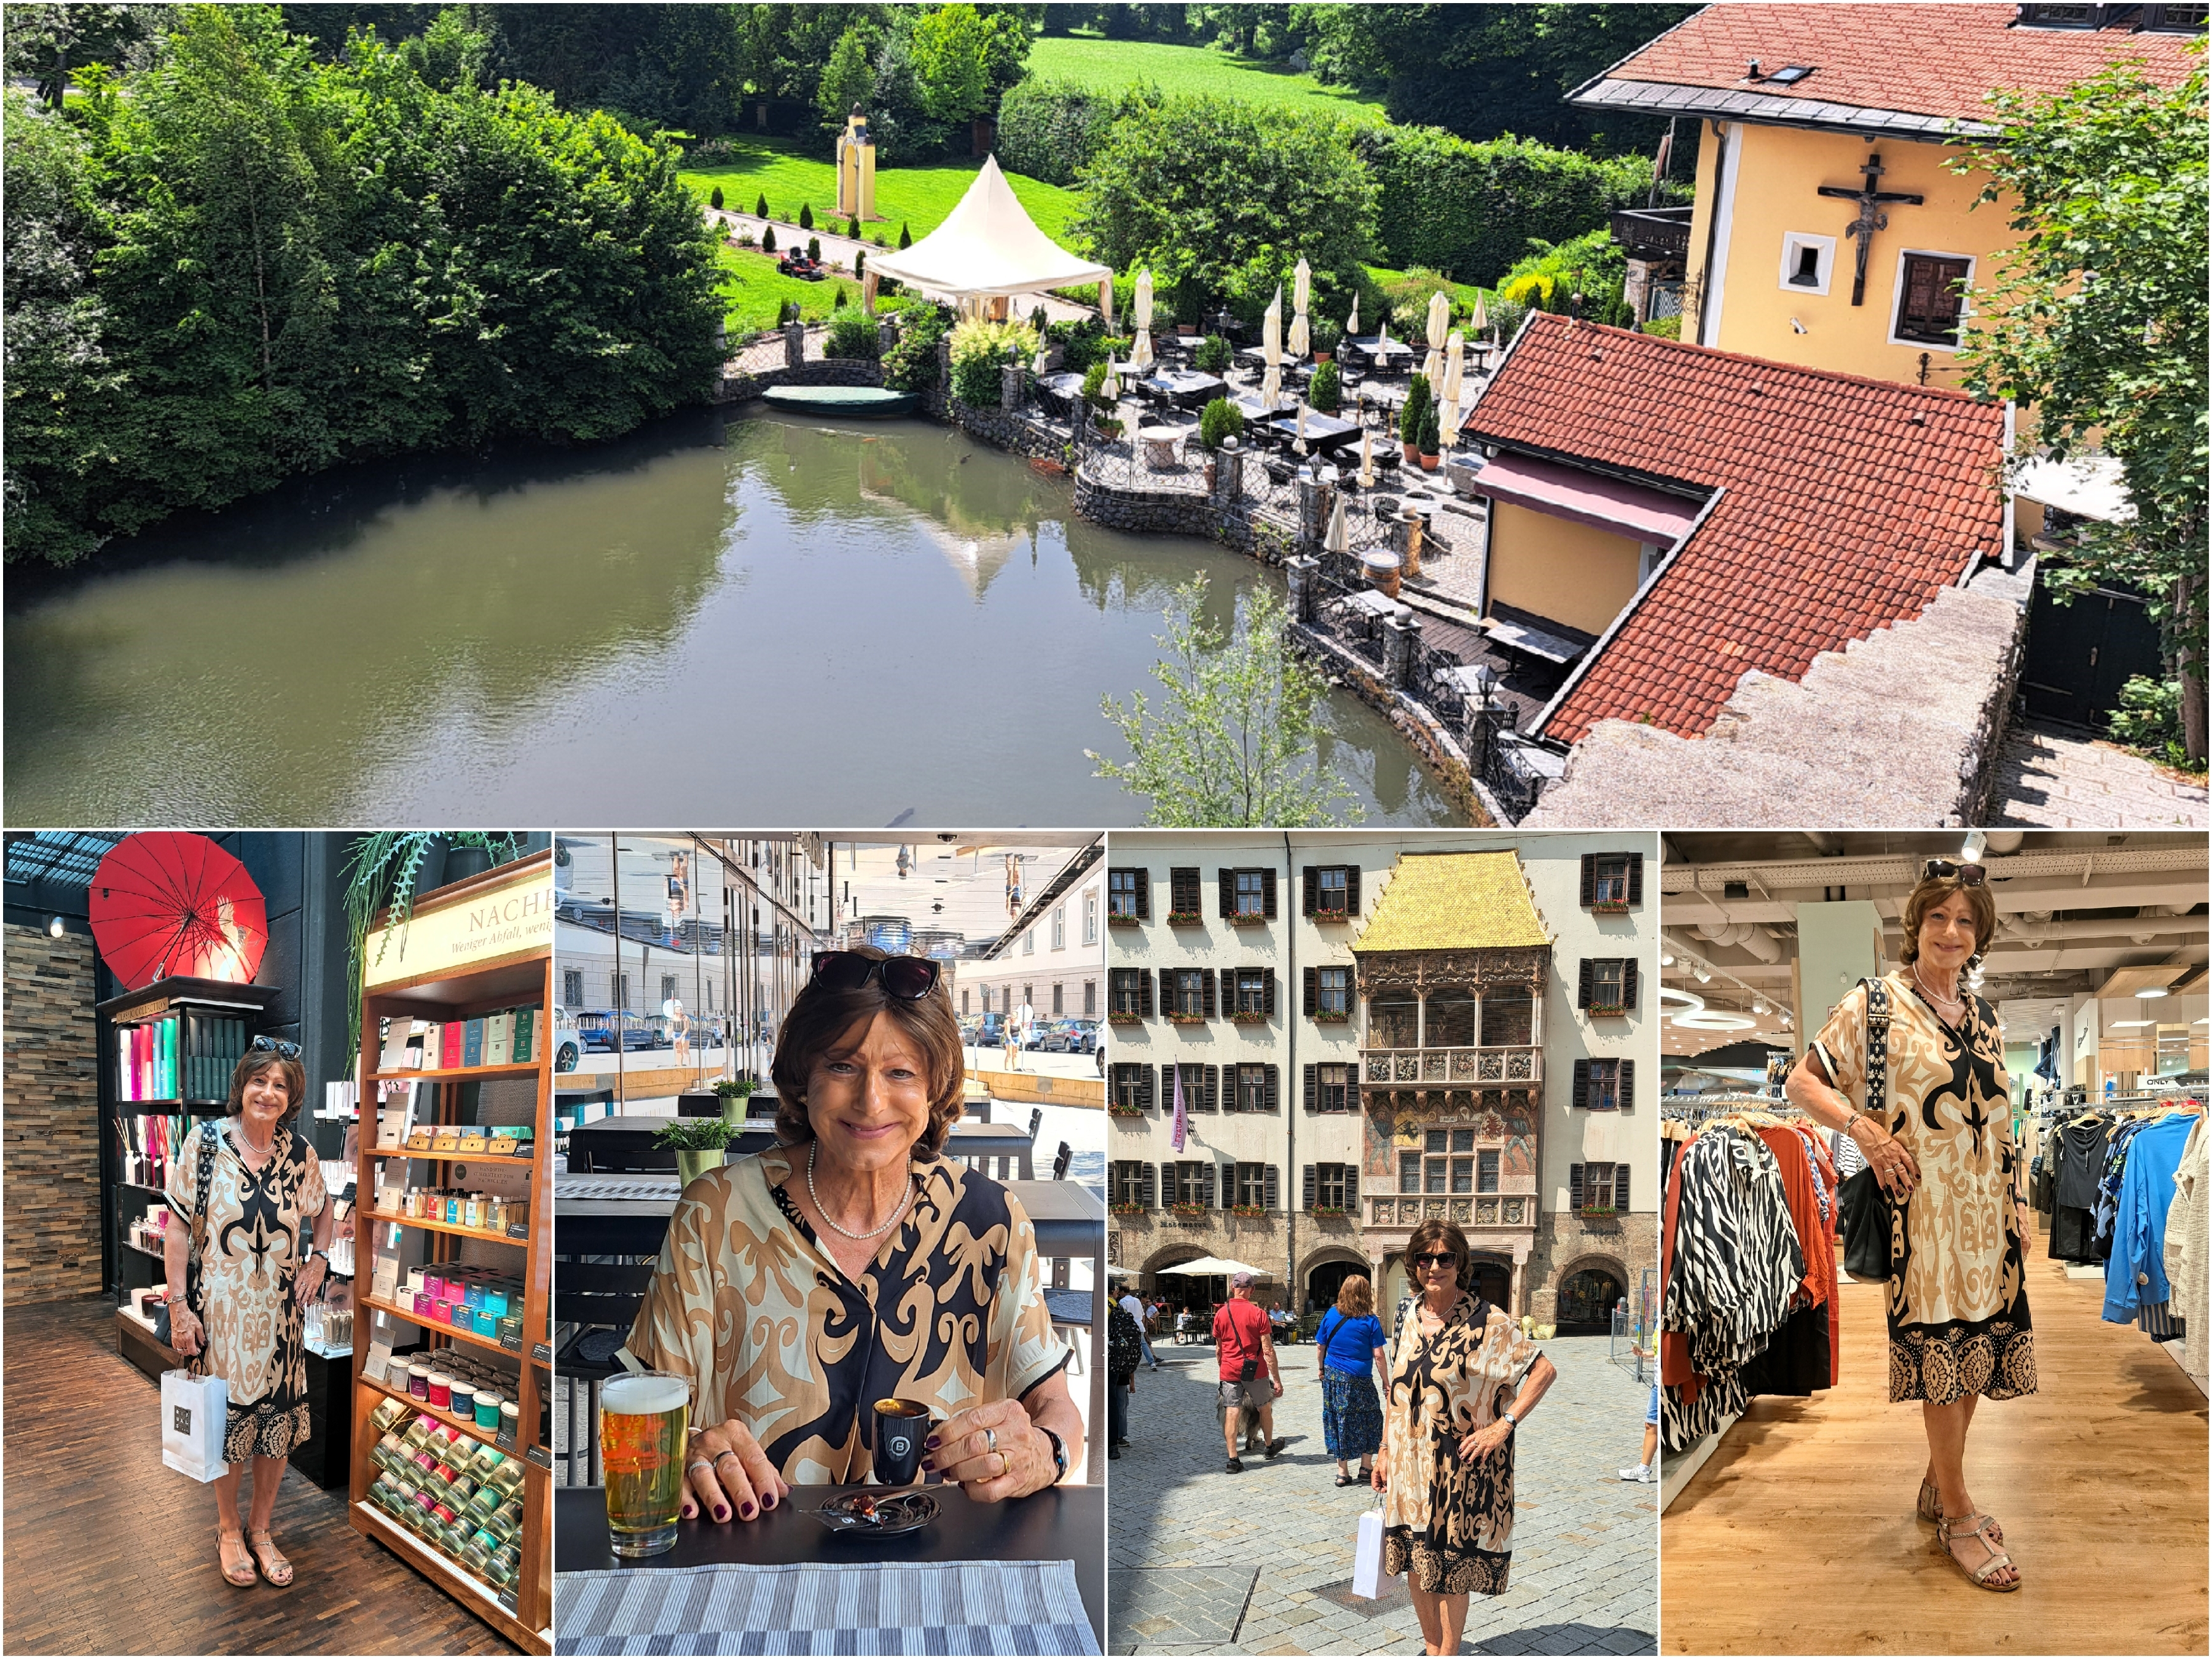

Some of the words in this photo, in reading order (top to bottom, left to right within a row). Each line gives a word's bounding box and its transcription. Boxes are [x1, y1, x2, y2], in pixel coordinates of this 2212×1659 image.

[452, 937, 487, 953] Weniger
[489, 926, 522, 944] Abfall,
[117, 1009, 135, 1021] CLASSIC
[135, 999, 167, 1017] COLLECTION
[896, 1441, 904, 1451] B
